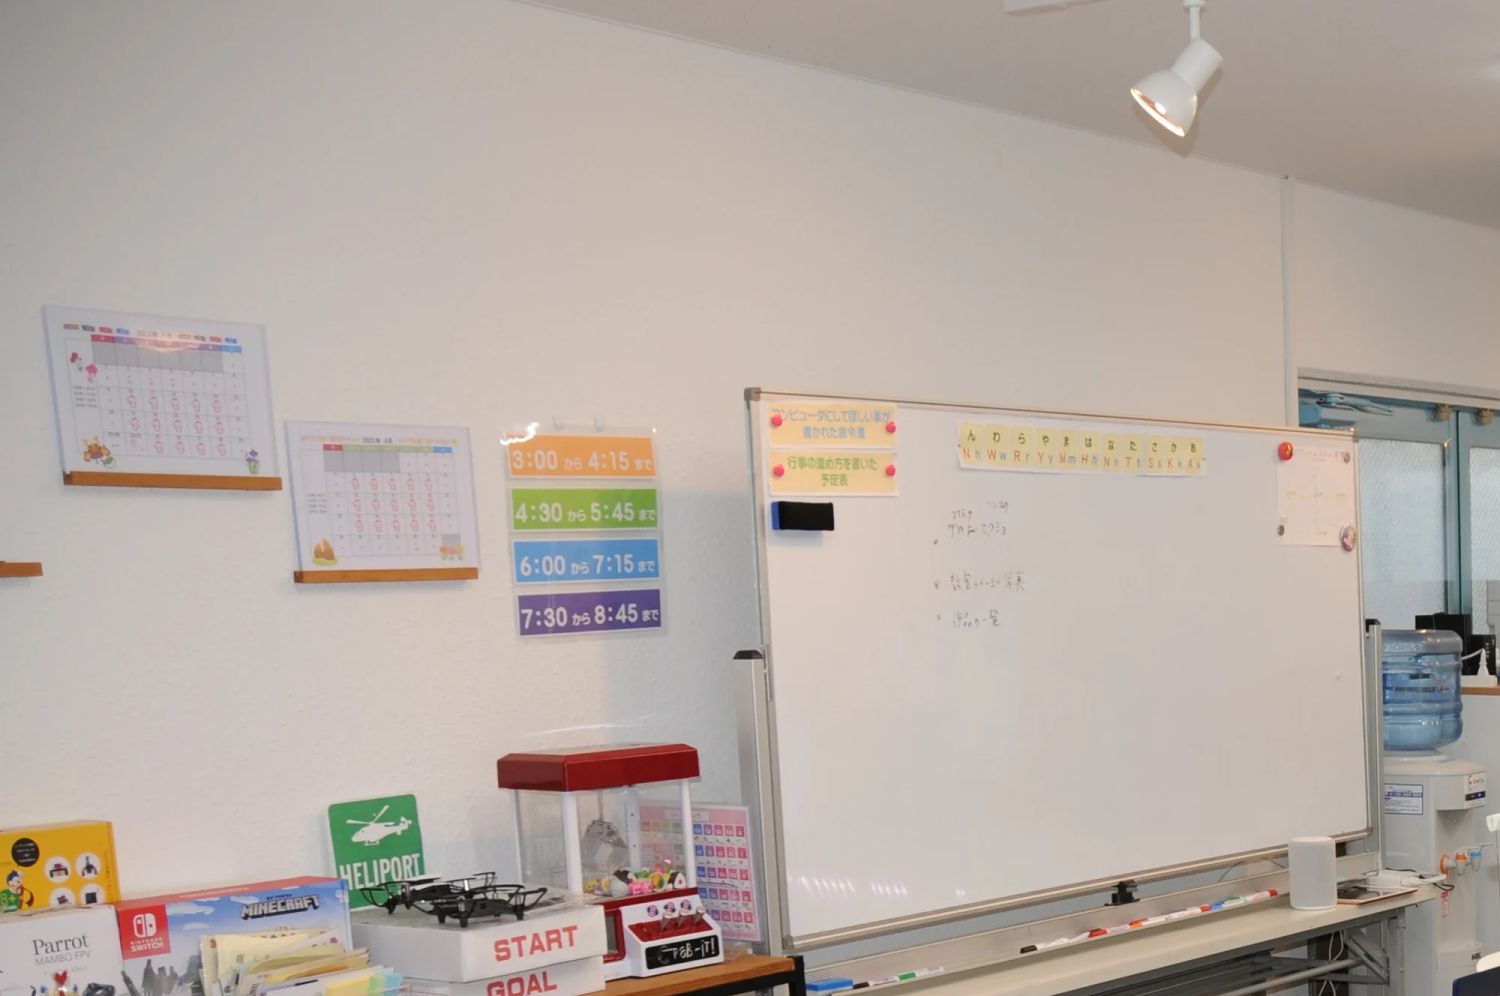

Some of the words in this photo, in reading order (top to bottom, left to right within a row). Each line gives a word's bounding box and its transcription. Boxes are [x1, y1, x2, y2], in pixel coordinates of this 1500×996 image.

[512, 450, 558, 470] 3:00
[564, 458, 583, 471] から
[588, 451, 630, 471] 4:15
[634, 458, 654, 471] まで
[787, 456, 877, 470] 行事の進め方を書いた
[821, 473, 848, 486] 予定表
[515, 502, 563, 523] 4:30
[568, 511, 586, 522] から
[590, 502, 635, 522] 5:45
[638, 509, 656, 521] まで
[520, 556, 566, 576] 6:00
[570, 561, 590, 575] から
[592, 554, 634, 574] 7:15
[638, 560, 656, 572] まで
[521, 606, 568, 629] 7:30
[572, 612, 591, 626] から
[594, 604, 639, 624] 8:45
[642, 610, 660, 622] まで
[340, 853, 421, 891] HELIPORT
[240, 894, 321, 919] MINECRAFT
[33, 935, 90, 955] Parrot
[131, 942, 165, 954] SWITCH
[494, 925, 578, 962] START
[35, 953, 73, 965] MAMBO
[75, 950, 91, 960] FPV
